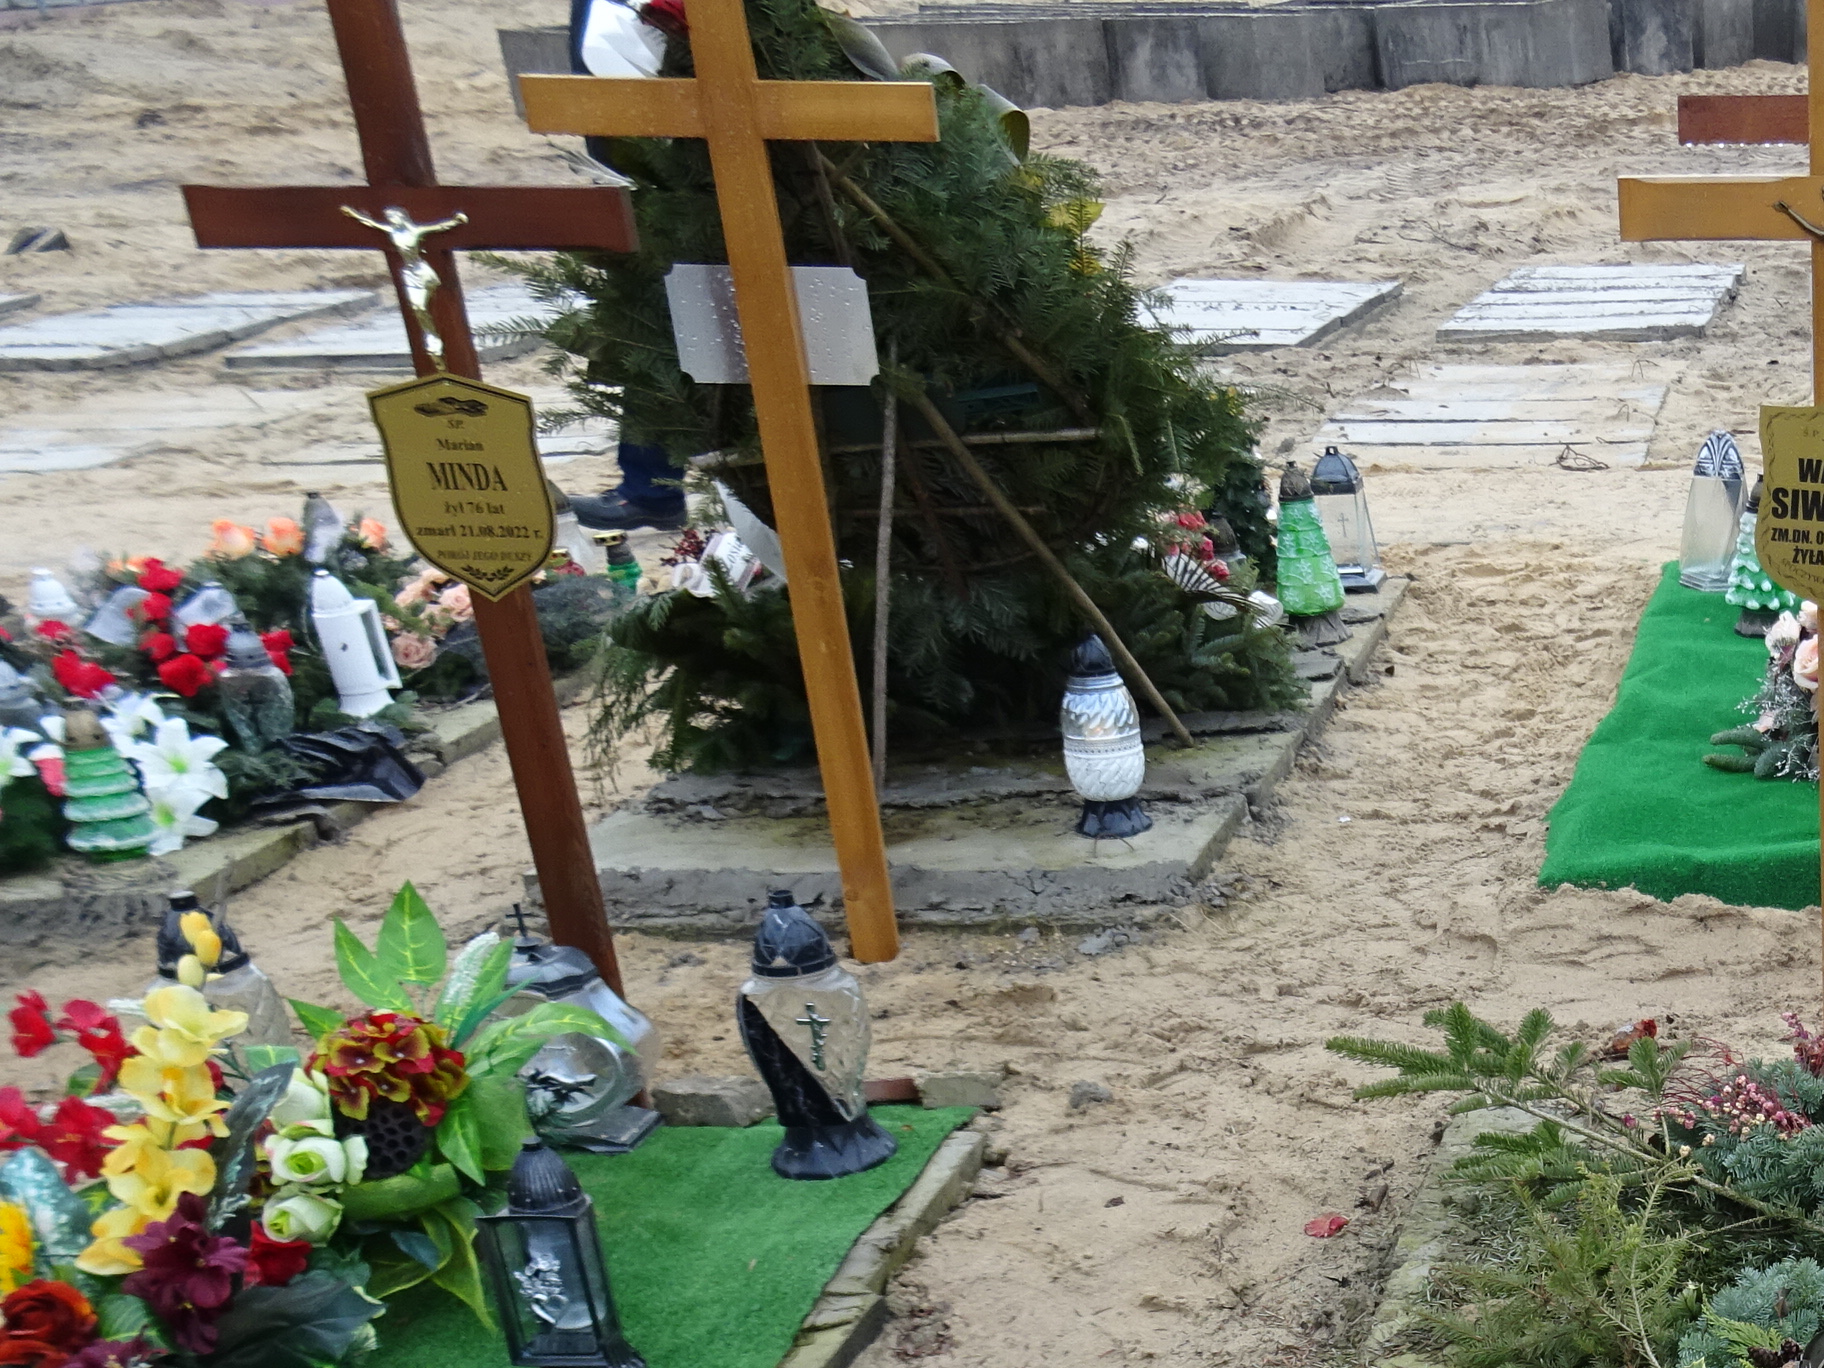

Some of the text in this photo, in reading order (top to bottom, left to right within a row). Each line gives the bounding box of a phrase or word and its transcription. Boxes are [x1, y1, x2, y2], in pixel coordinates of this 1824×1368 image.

[436, 438, 484, 451] Marian
[426, 461, 508, 491] MINDA
[466, 501, 484, 514] 76
[486, 502, 505, 515] lat
[459, 525, 530, 539] 21.08.2022
[1770, 527, 1813, 544] ZM.DN.
[1792, 546, 1824, 566] ŻYŁA
